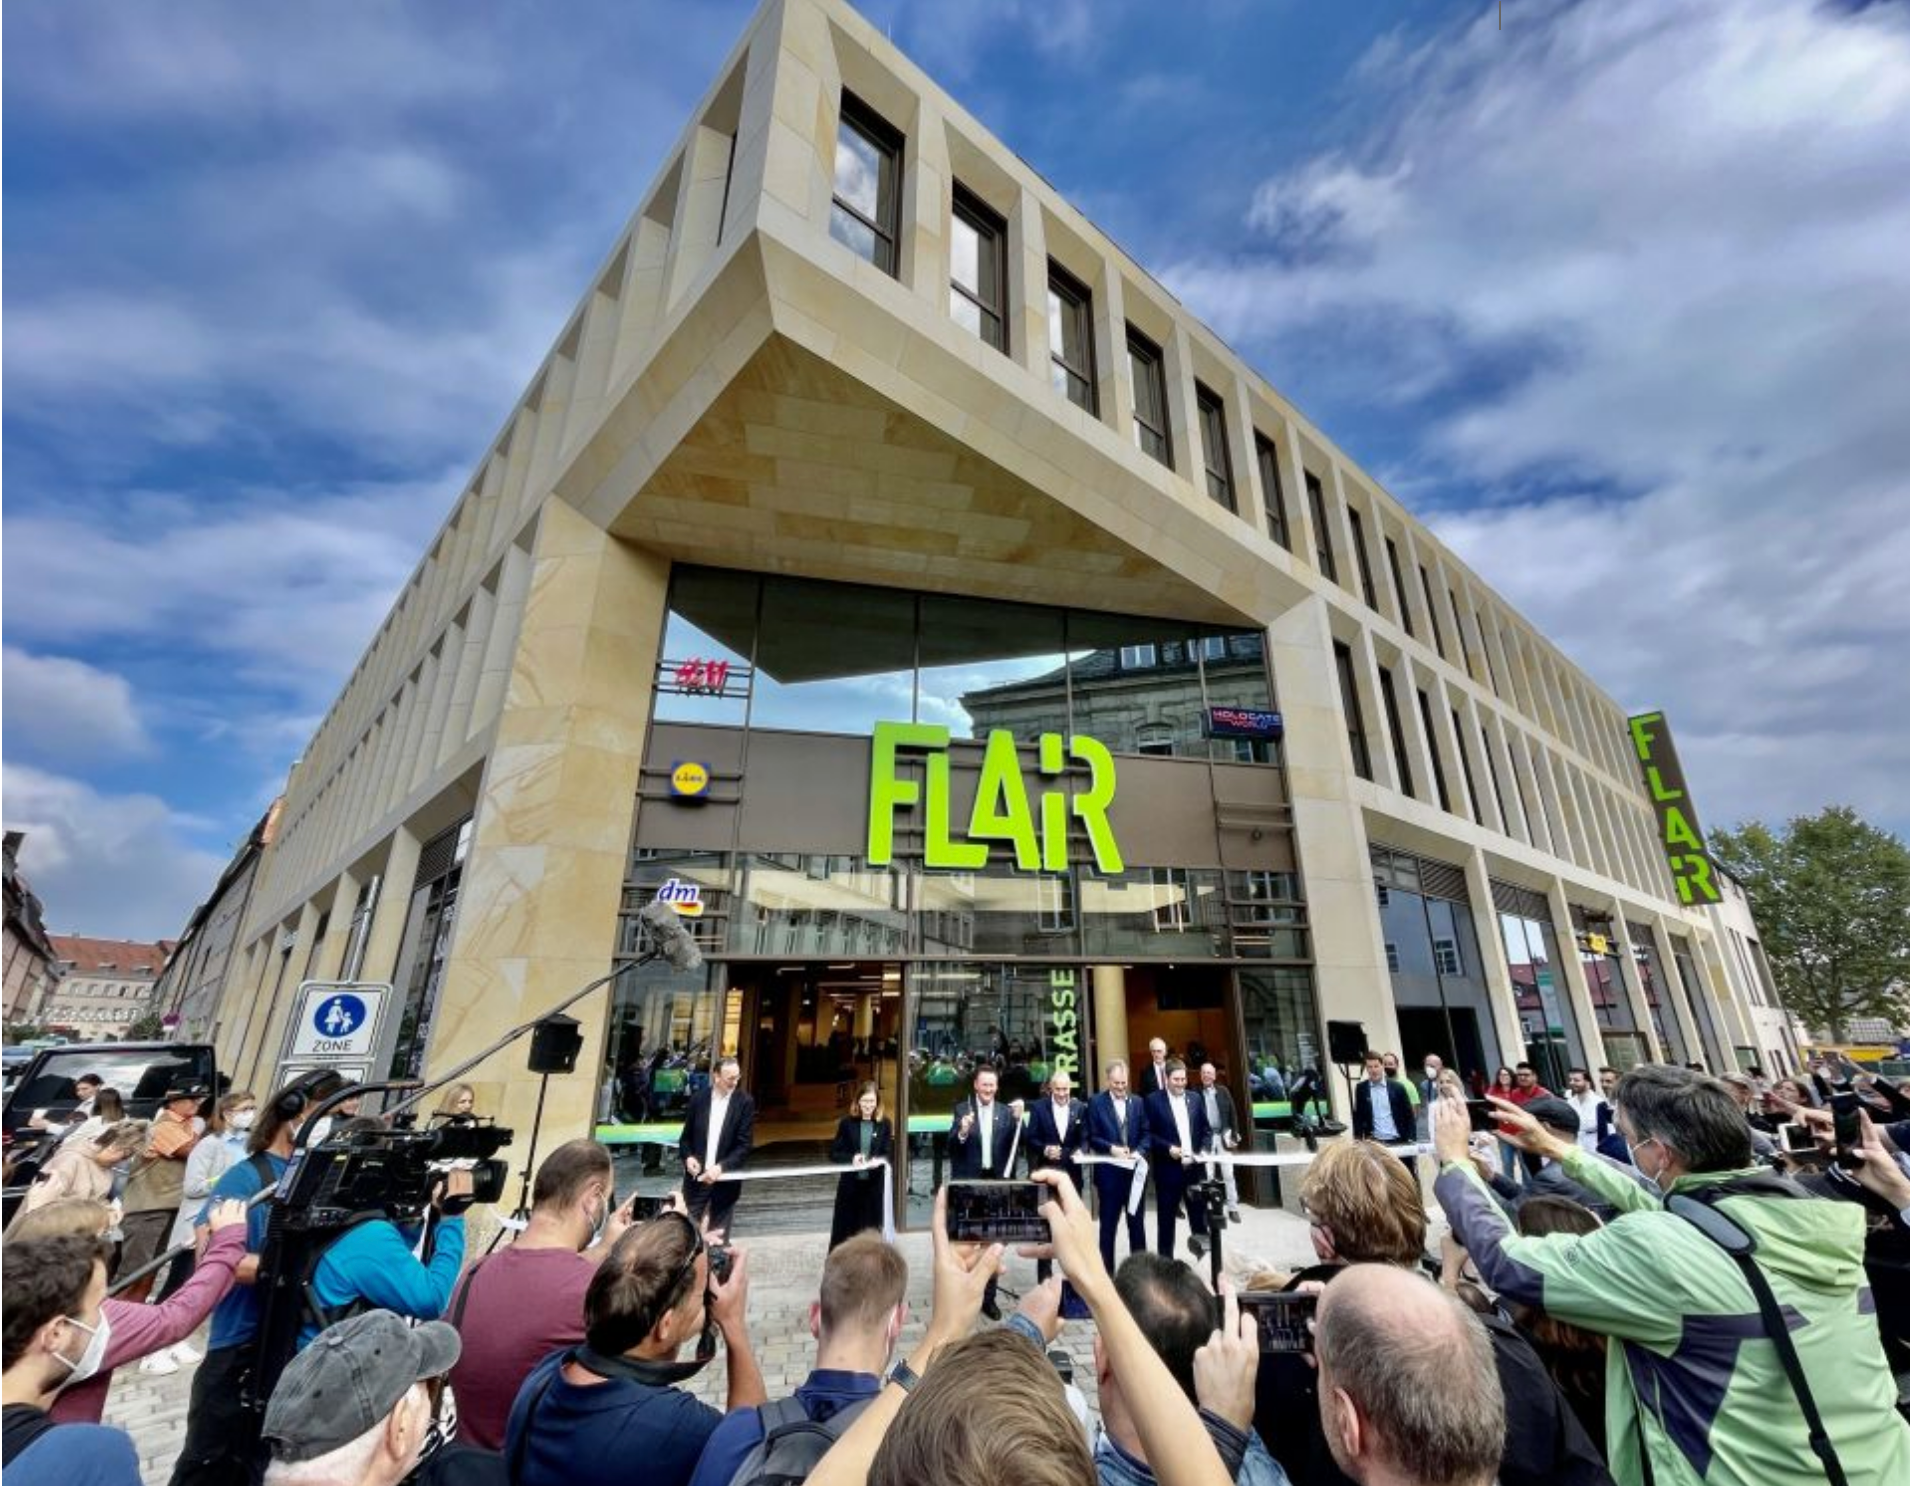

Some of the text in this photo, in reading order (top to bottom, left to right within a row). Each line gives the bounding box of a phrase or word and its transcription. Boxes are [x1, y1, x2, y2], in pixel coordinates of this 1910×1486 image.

[868, 721, 1124, 873] FLAIR
[658, 878, 700, 902] dm
[312, 1039, 353, 1052] ZONE
